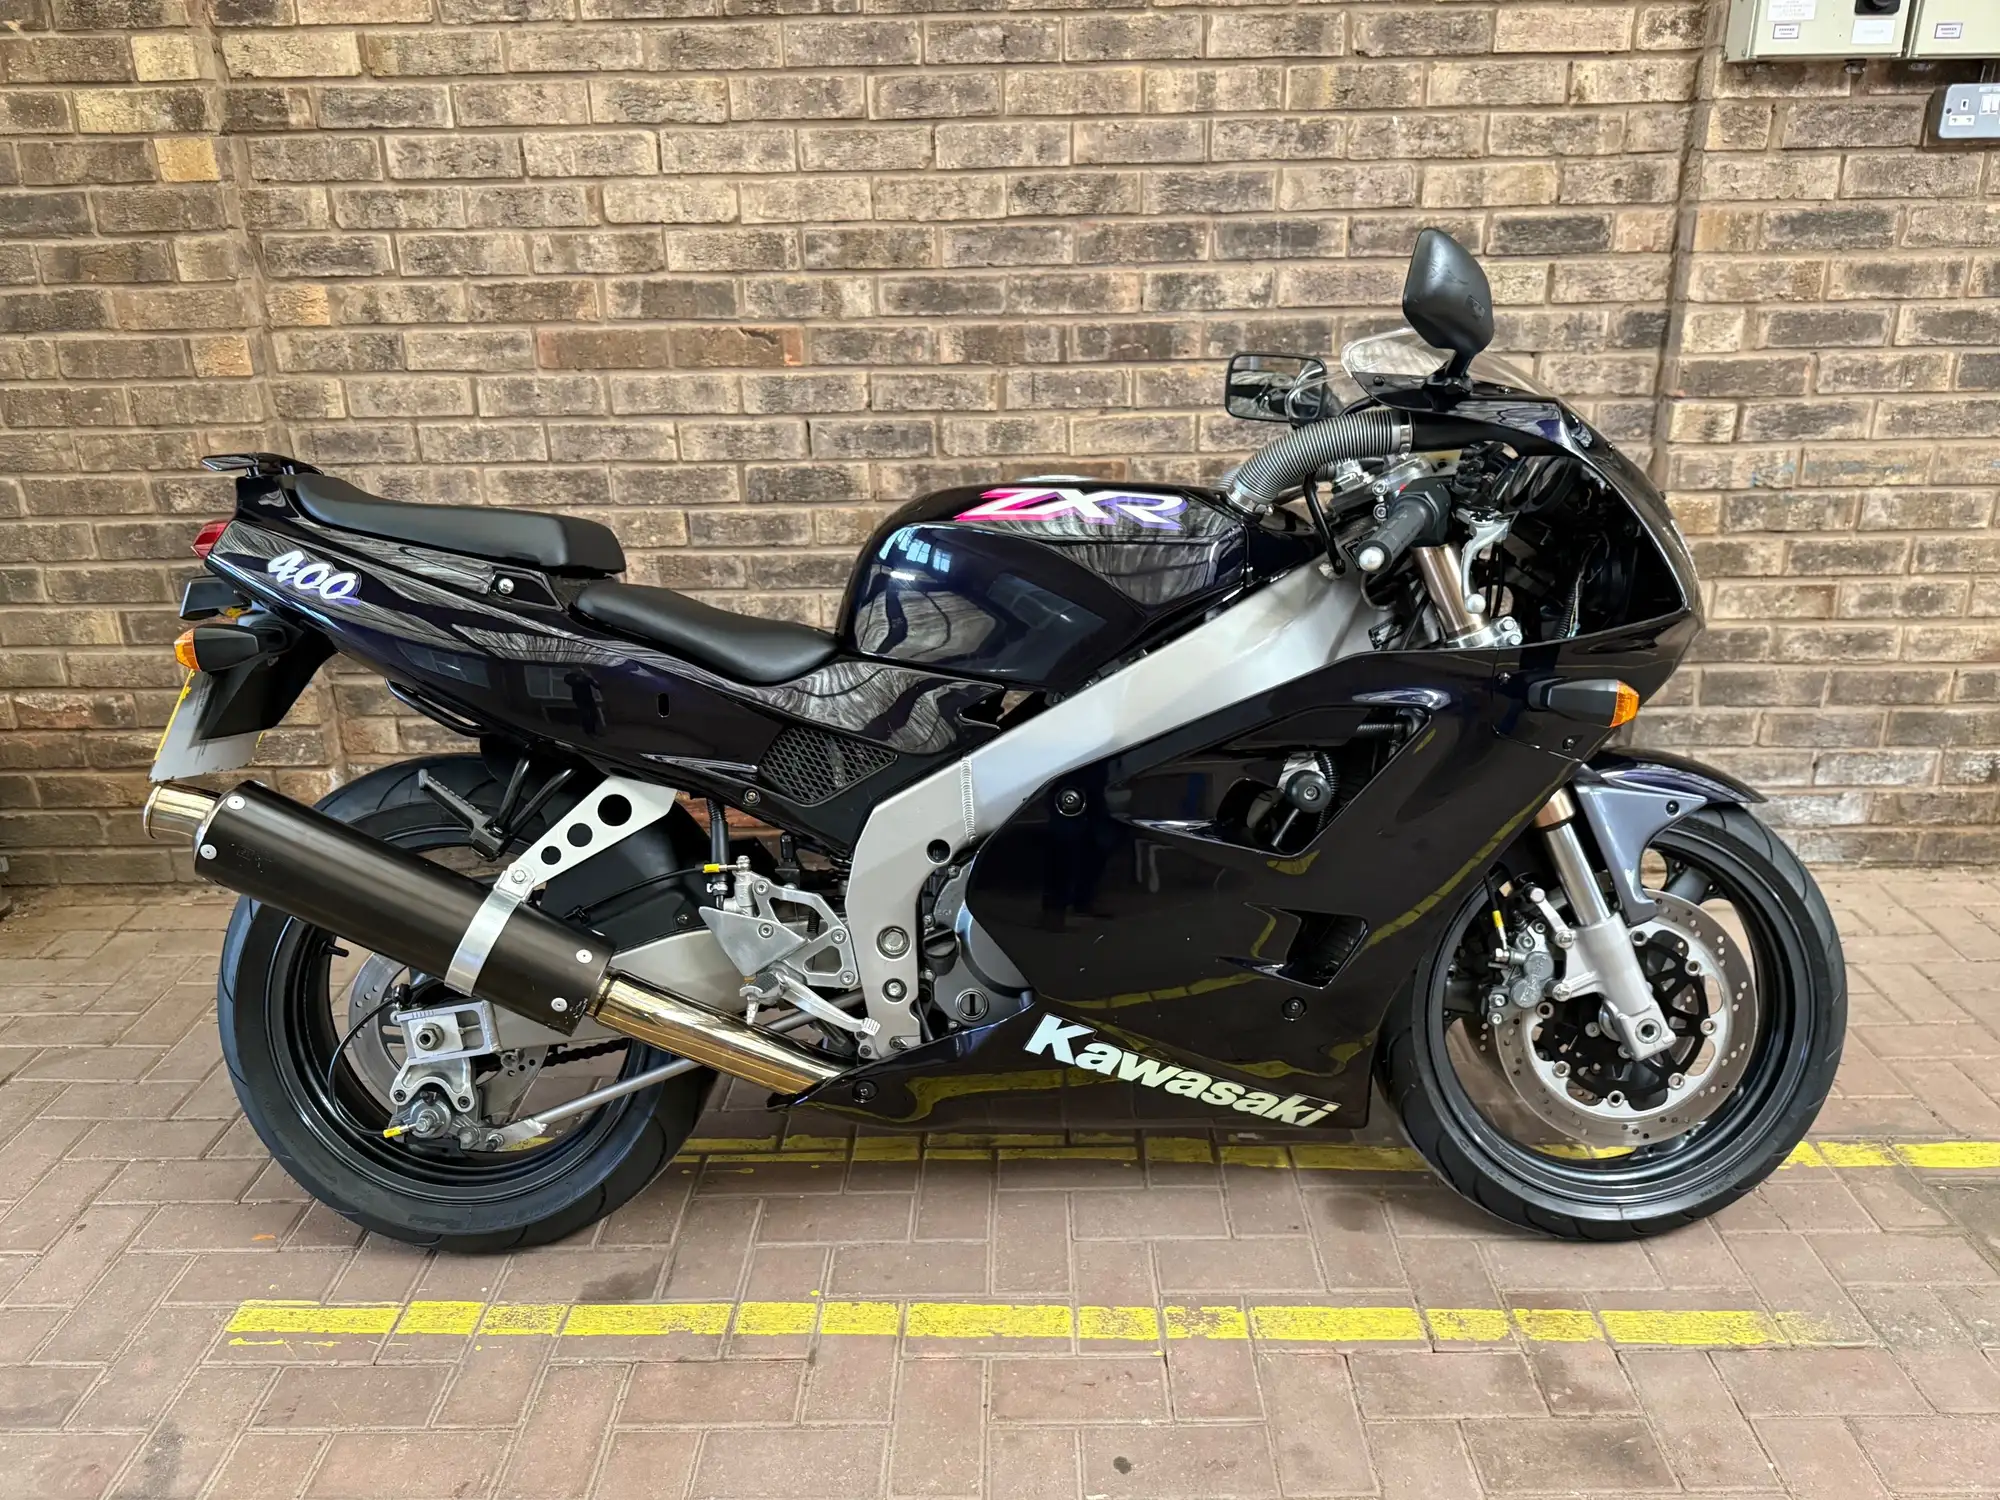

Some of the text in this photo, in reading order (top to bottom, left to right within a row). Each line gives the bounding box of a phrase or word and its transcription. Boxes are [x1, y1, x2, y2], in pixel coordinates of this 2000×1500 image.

[953, 487, 1188, 531] ZXR
[267, 550, 361, 606] 400
[1024, 1013, 1341, 1127] Kawasaki
